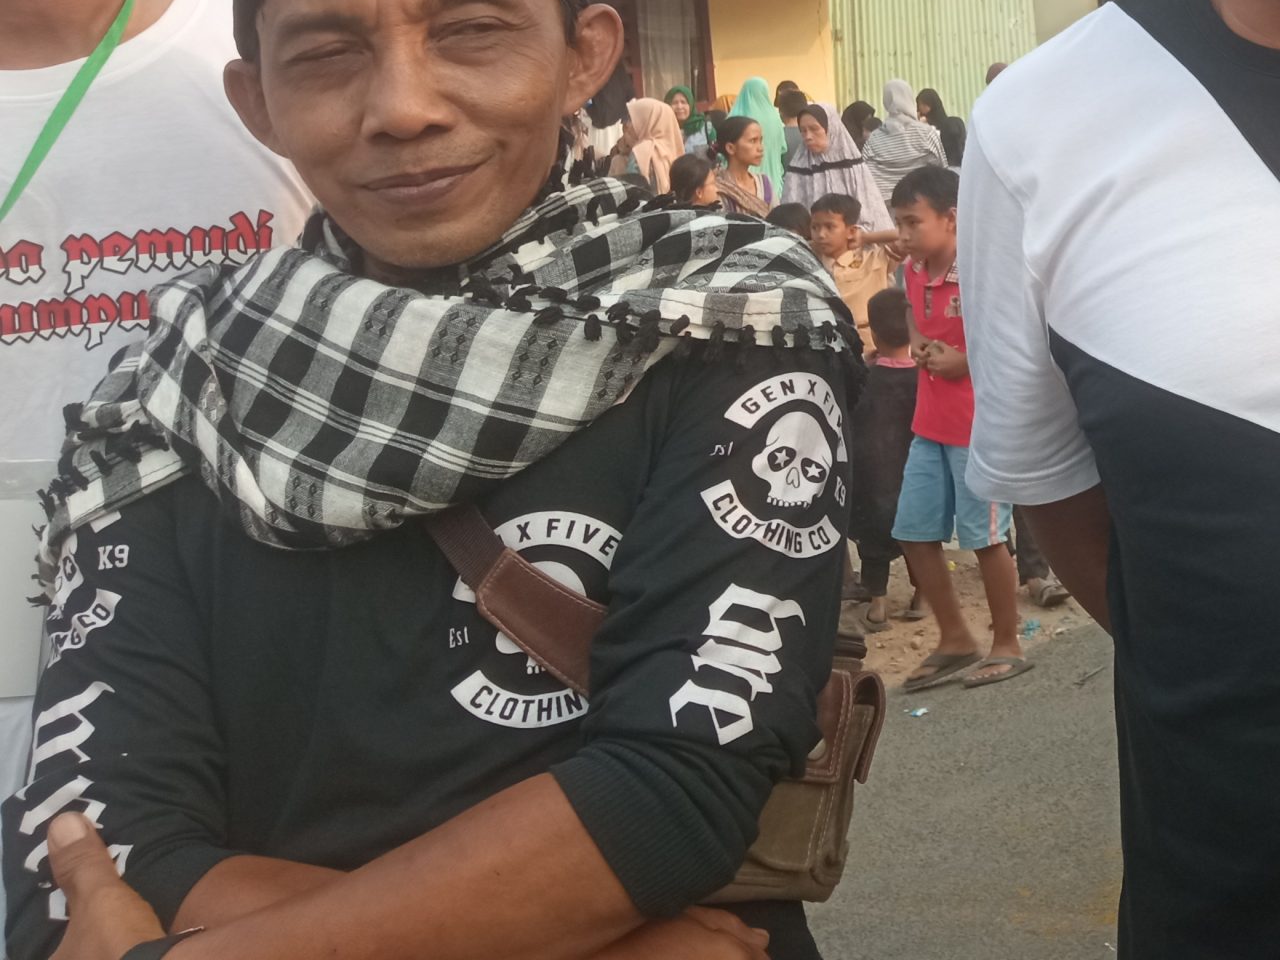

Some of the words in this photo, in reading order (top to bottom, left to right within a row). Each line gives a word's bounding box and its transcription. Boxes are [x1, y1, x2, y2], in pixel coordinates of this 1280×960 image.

[741, 379, 796, 414] GEN
[516, 521, 532, 543] X
[546, 518, 620, 557] FIVE
[712, 493, 803, 554] CLOTHING
[808, 525, 831, 551] CO
[97, 544, 130, 570] K9
